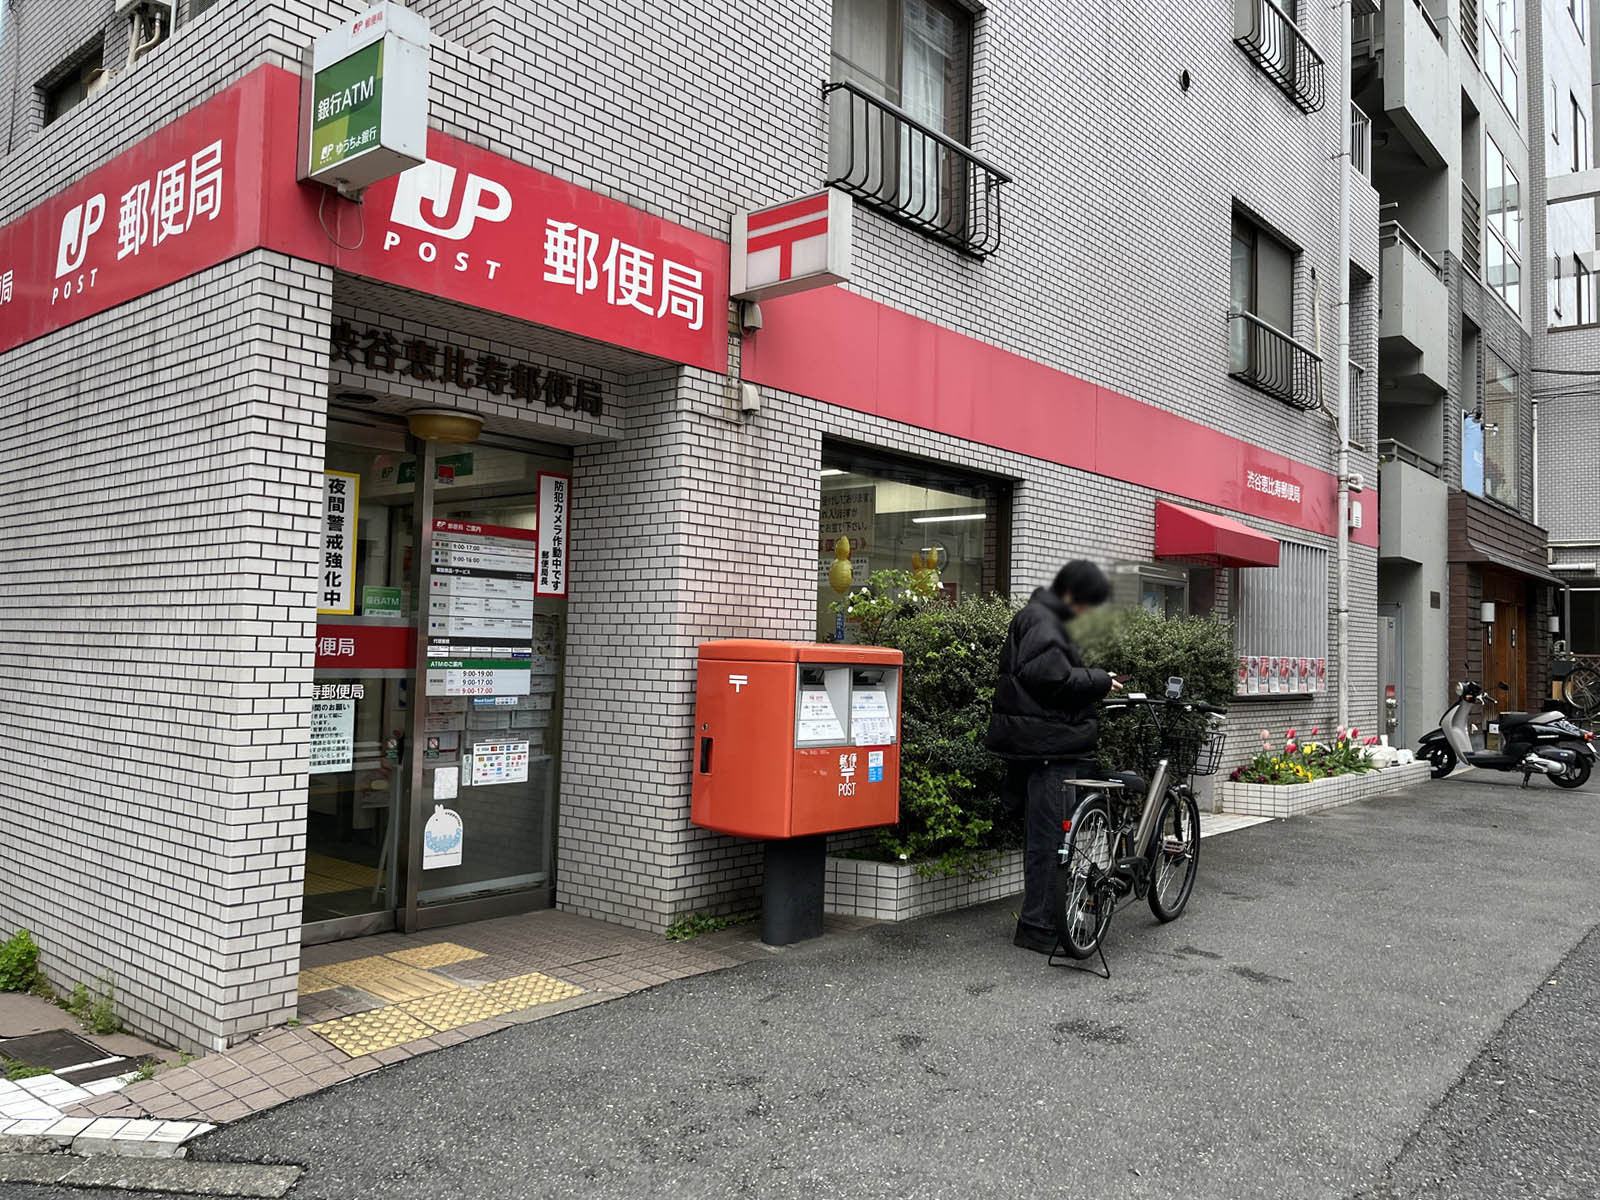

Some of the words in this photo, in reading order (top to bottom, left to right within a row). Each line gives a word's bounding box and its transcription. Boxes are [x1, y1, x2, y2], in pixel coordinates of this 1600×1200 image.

[317, 75, 374, 121] 銀行ATM
[336, 125, 377, 155] ゆうちょ銀行
[117, 139, 223, 262] 郵便局
[55, 192, 106, 280] JP
[383, 230, 501, 280] POST
[52, 268, 98, 305] POST
[543, 216, 704, 331] 郵便局
[324, 478, 347, 607] 夜間警戒強化中
[551, 480, 565, 592] 防犯カメラ作動中です
[838, 782, 857, 797] POST
